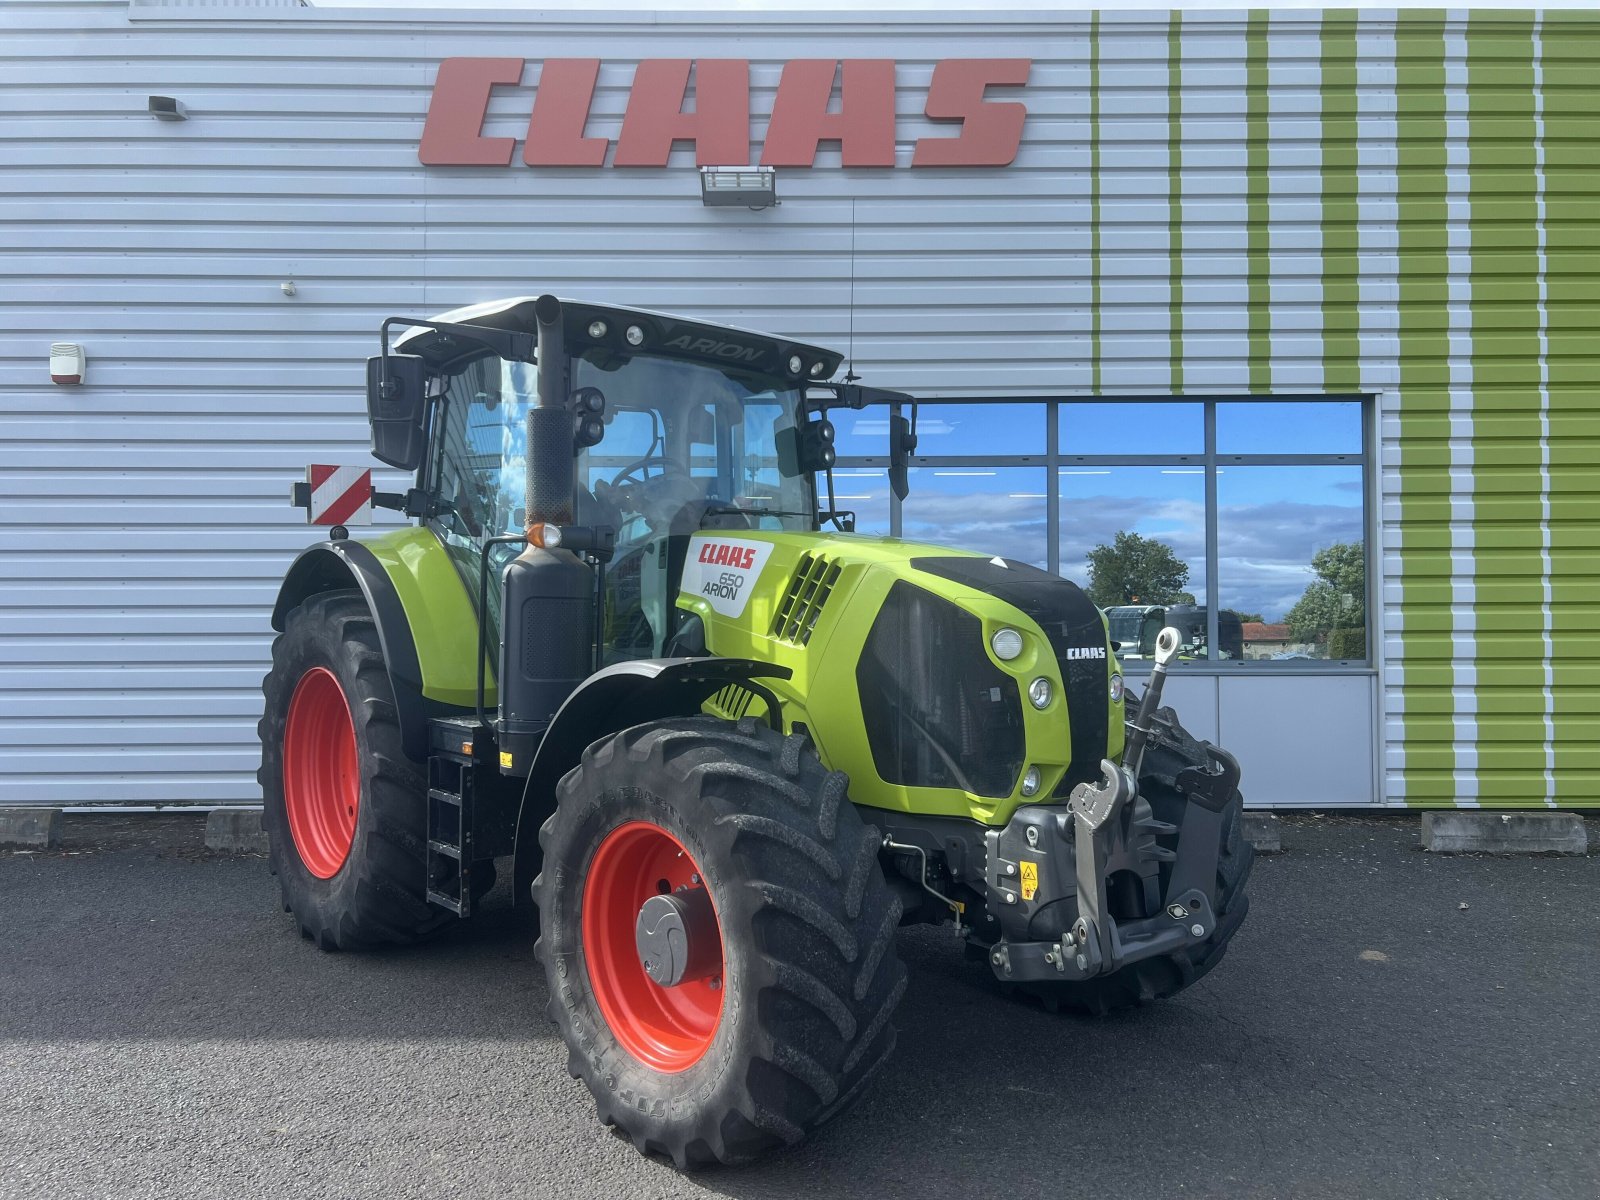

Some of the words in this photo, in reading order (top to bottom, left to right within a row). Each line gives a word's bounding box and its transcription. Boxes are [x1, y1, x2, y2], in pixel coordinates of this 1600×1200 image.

[418, 57, 1032, 168] CLAAS
[664, 335, 766, 361] ARION
[698, 543, 757, 570] CLAAS
[702, 581, 738, 601] ARION
[719, 572, 744, 589] 650
[1066, 647, 1106, 660] CLAAS
